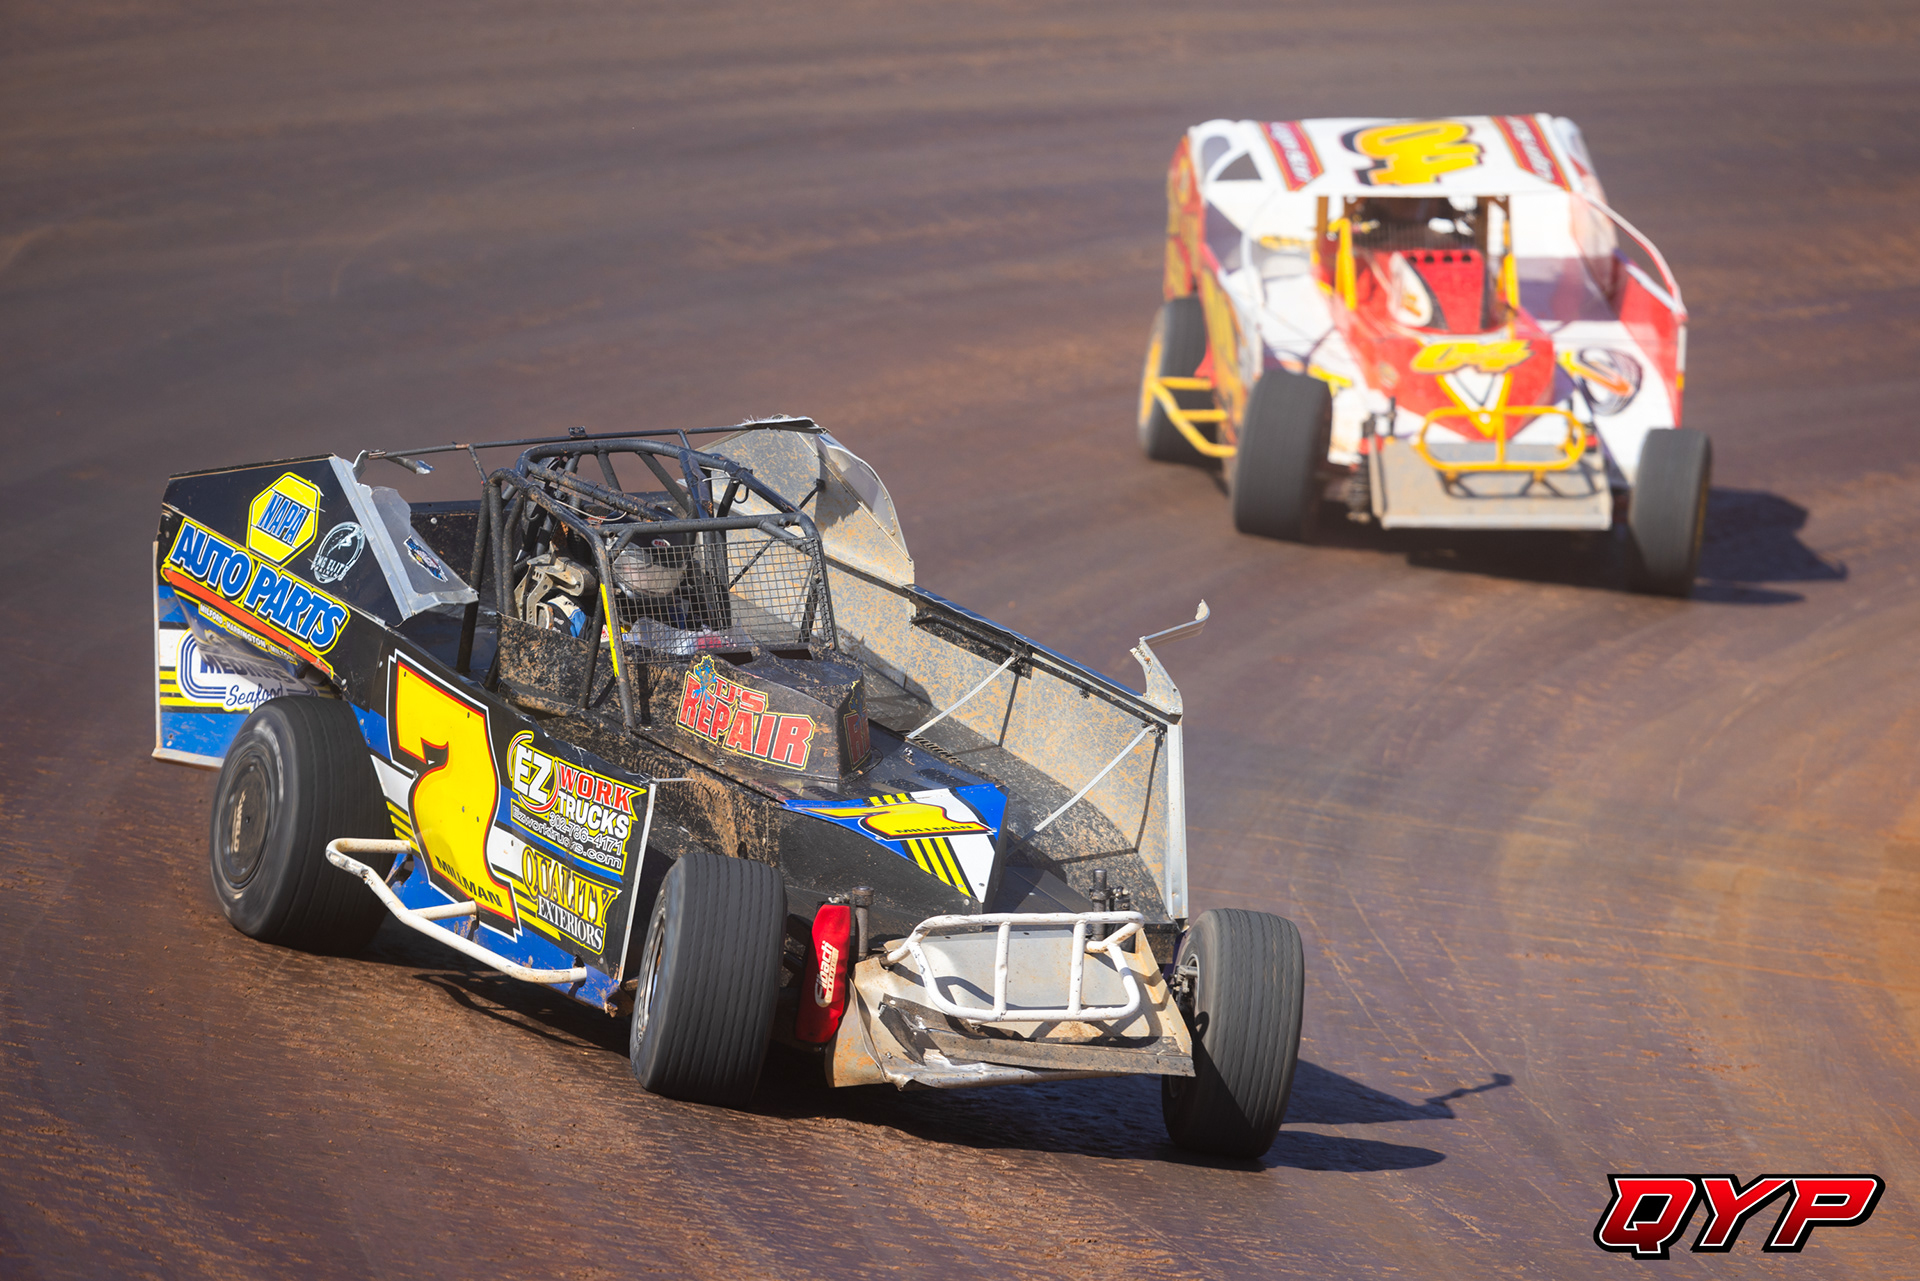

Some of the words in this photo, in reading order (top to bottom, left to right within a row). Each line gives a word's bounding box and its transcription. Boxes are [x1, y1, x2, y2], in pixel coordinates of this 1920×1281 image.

[258, 493, 308, 545] NAPA
[170, 522, 252, 597] AUTO
[243, 564, 347, 647] PARTS
[200, 603, 223, 624] MILFORD
[226, 621, 266, 648] HARRINGTON
[226, 681, 283, 709] Seafood
[679, 675, 813, 766] REPAIR
[396, 661, 516, 922] 7
[514, 744, 552, 804] EZ
[560, 763, 635, 814] WORK
[559, 791, 630, 839] TRUCKS
[435, 855, 503, 908] MILLMAN
[523, 849, 615, 928] QUALITY
[538, 895, 603, 949] EXTERIORS
